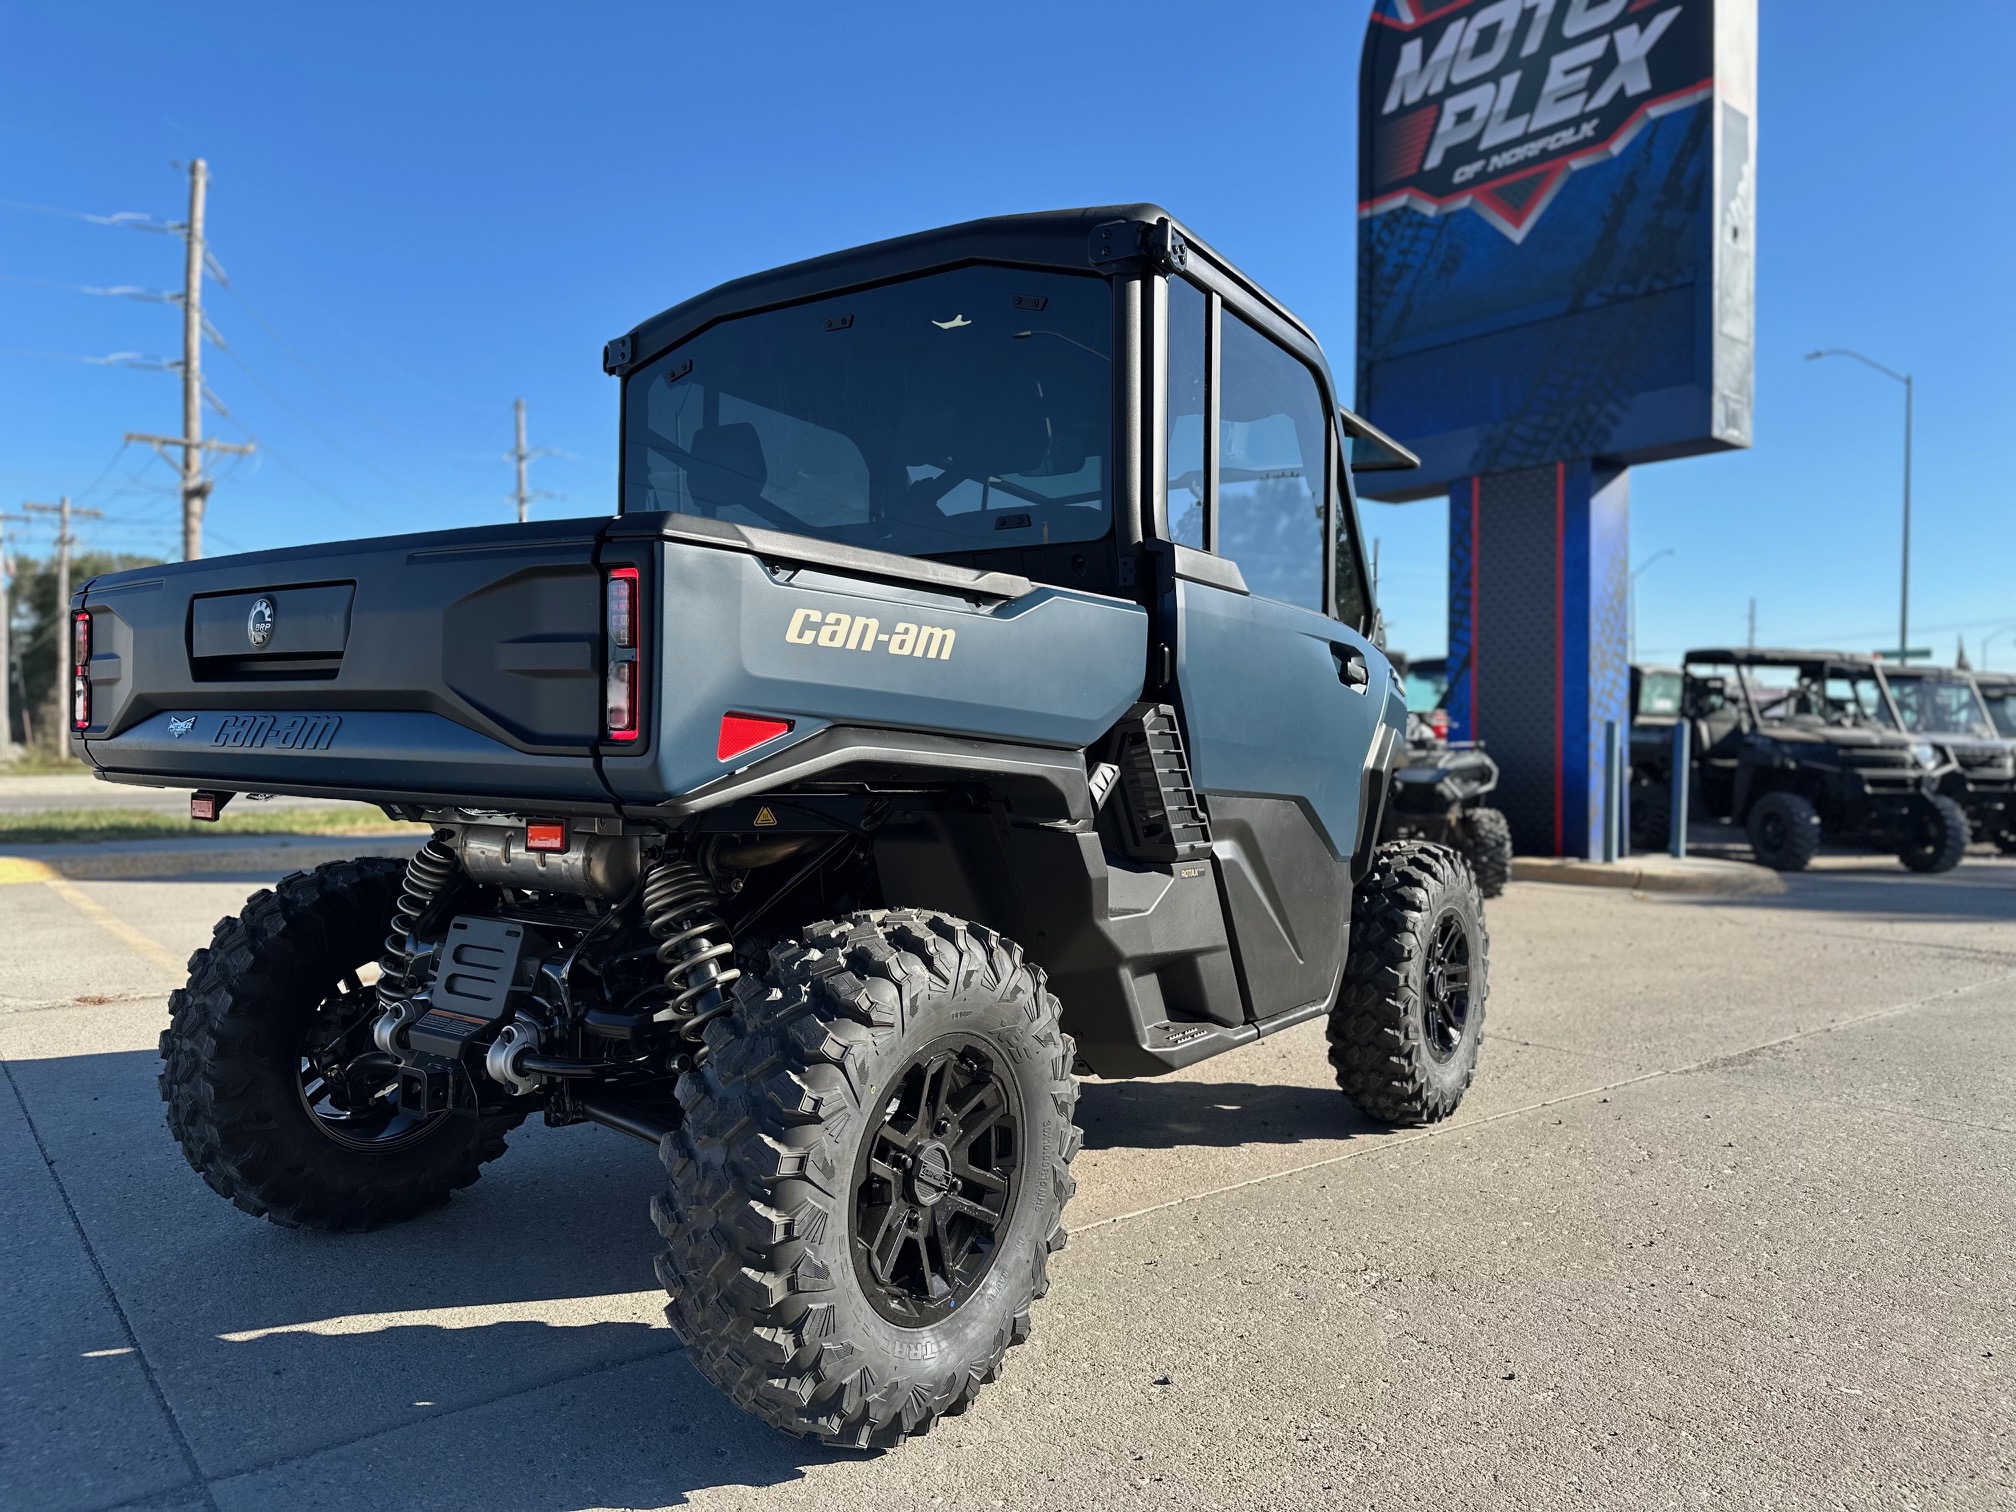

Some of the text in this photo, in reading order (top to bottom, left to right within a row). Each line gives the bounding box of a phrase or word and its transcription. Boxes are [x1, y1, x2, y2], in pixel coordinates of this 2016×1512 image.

[1424, 5, 1683, 171] PLEX
[1452, 118, 1600, 184] OF NORFOLK
[785, 608, 956, 660] can-am
[209, 715, 343, 750] can-am
[1181, 868, 1199, 878] ROTAX
